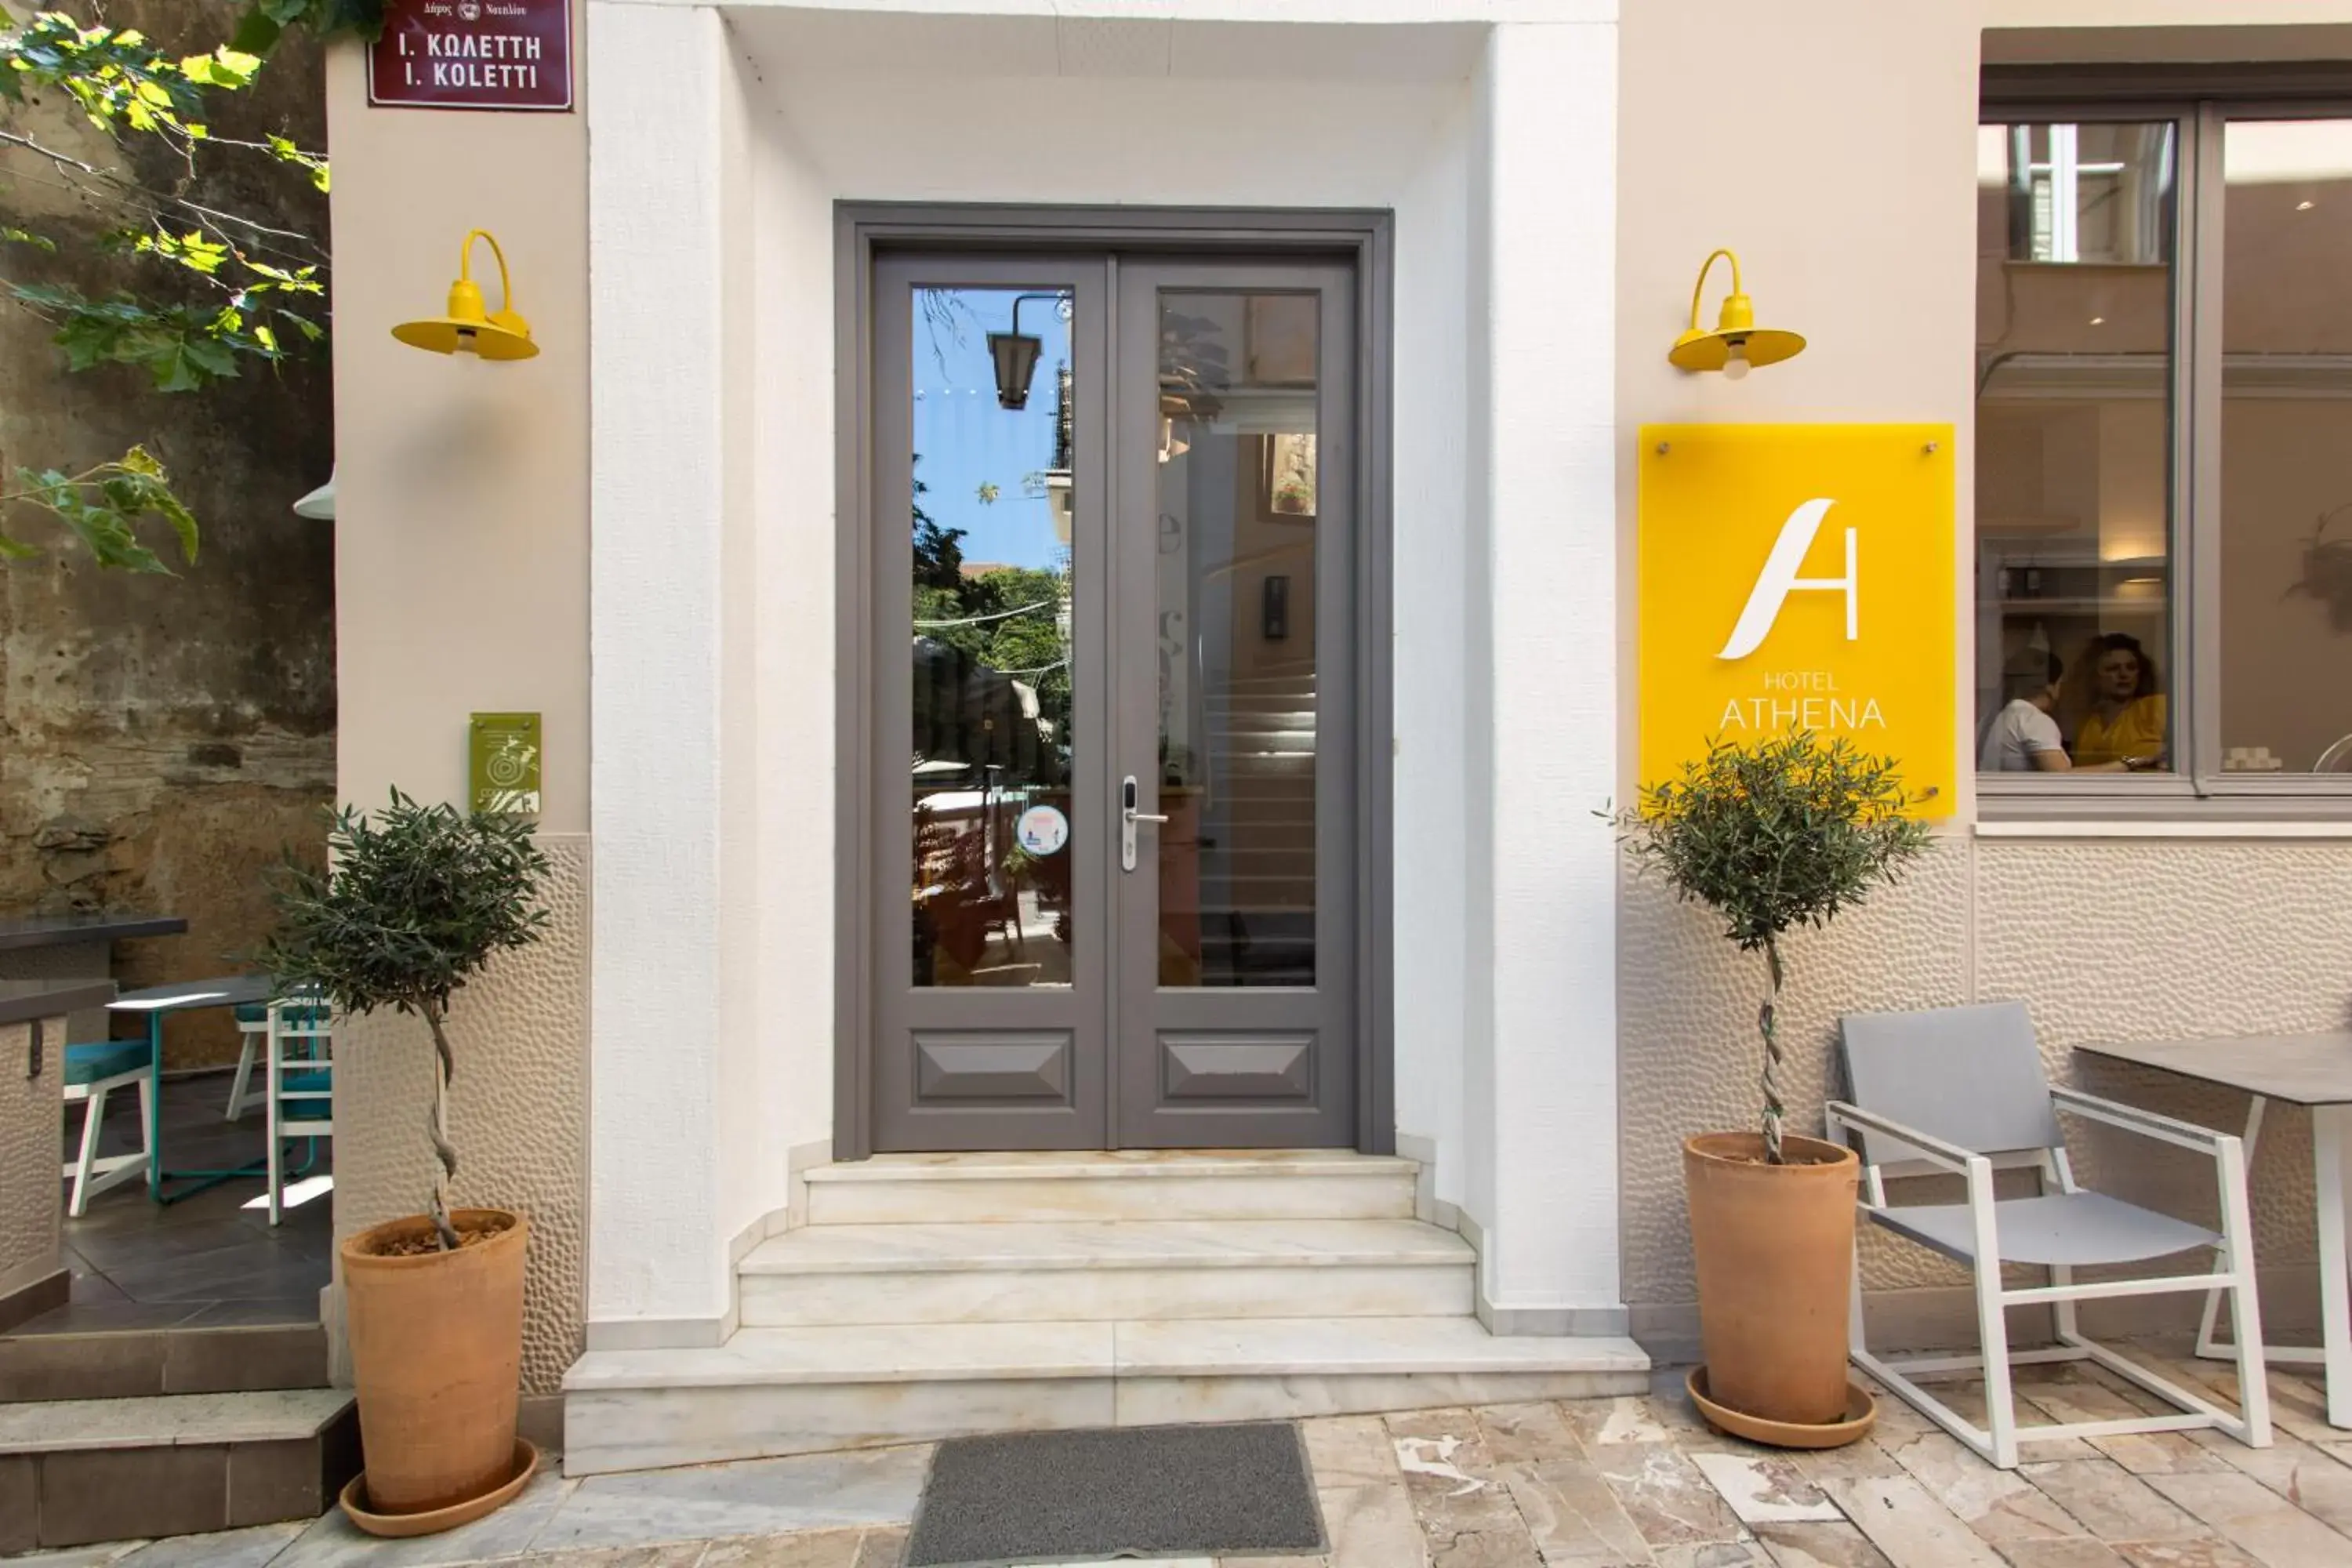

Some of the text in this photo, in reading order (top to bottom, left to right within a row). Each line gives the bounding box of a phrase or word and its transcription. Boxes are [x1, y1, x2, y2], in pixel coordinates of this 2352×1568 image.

[427, 34, 541, 60] ΚΩΛΕΤΤΗ
[405, 62, 537, 89] I. KOLETTI
[1764, 671, 1840, 691] HOTEL
[1719, 697, 1886, 730] ATHENA
